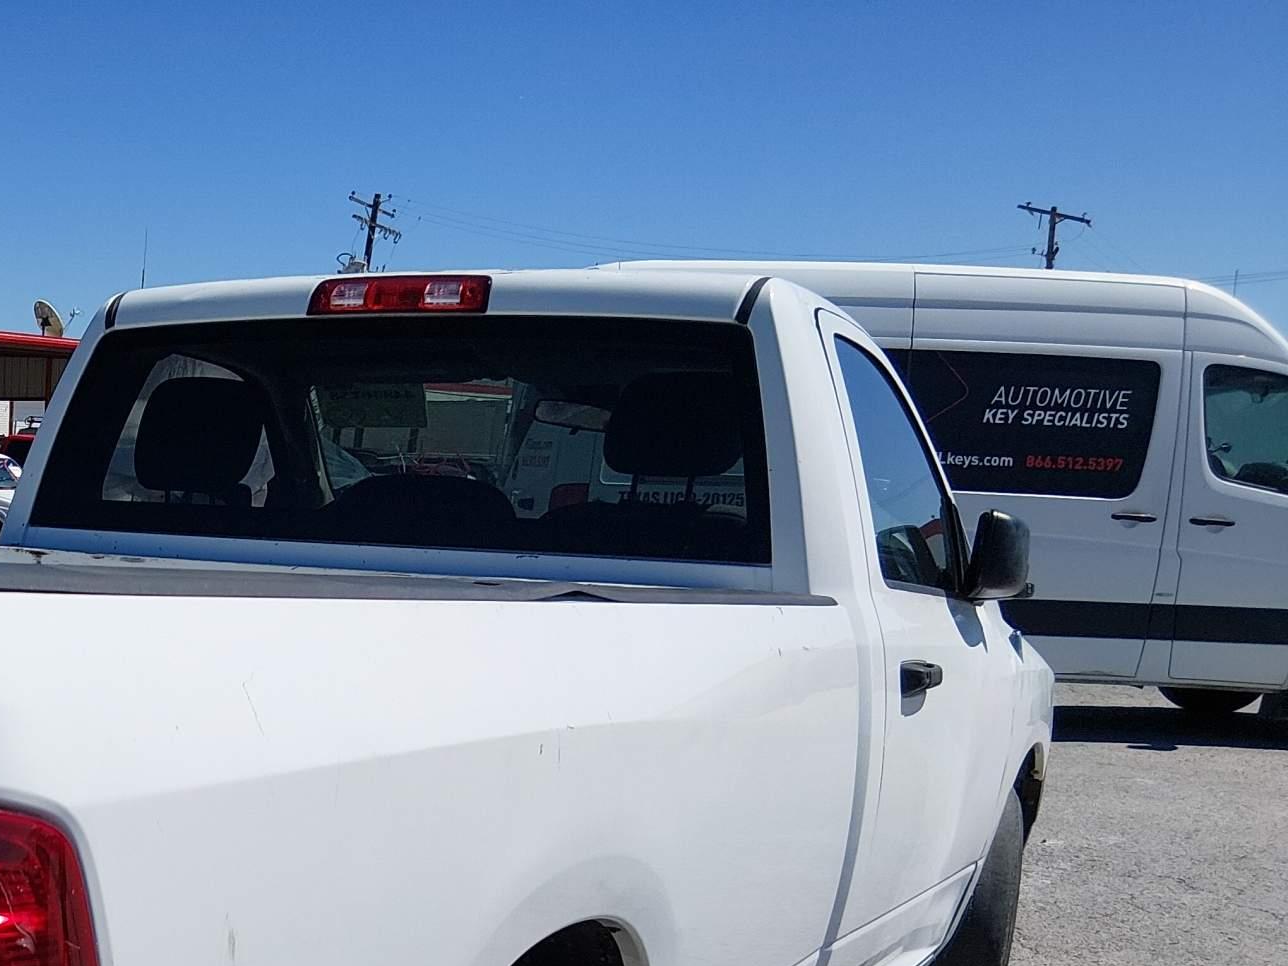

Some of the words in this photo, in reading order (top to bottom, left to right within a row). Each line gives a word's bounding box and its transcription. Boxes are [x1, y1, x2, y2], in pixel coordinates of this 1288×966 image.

[991, 386, 1133, 410] AUTOMOTIVE
[983, 408, 1018, 424] KEY
[1021, 410, 1130, 428] SPECIALISTS
[1026, 455, 1124, 471] 866.512.5397
